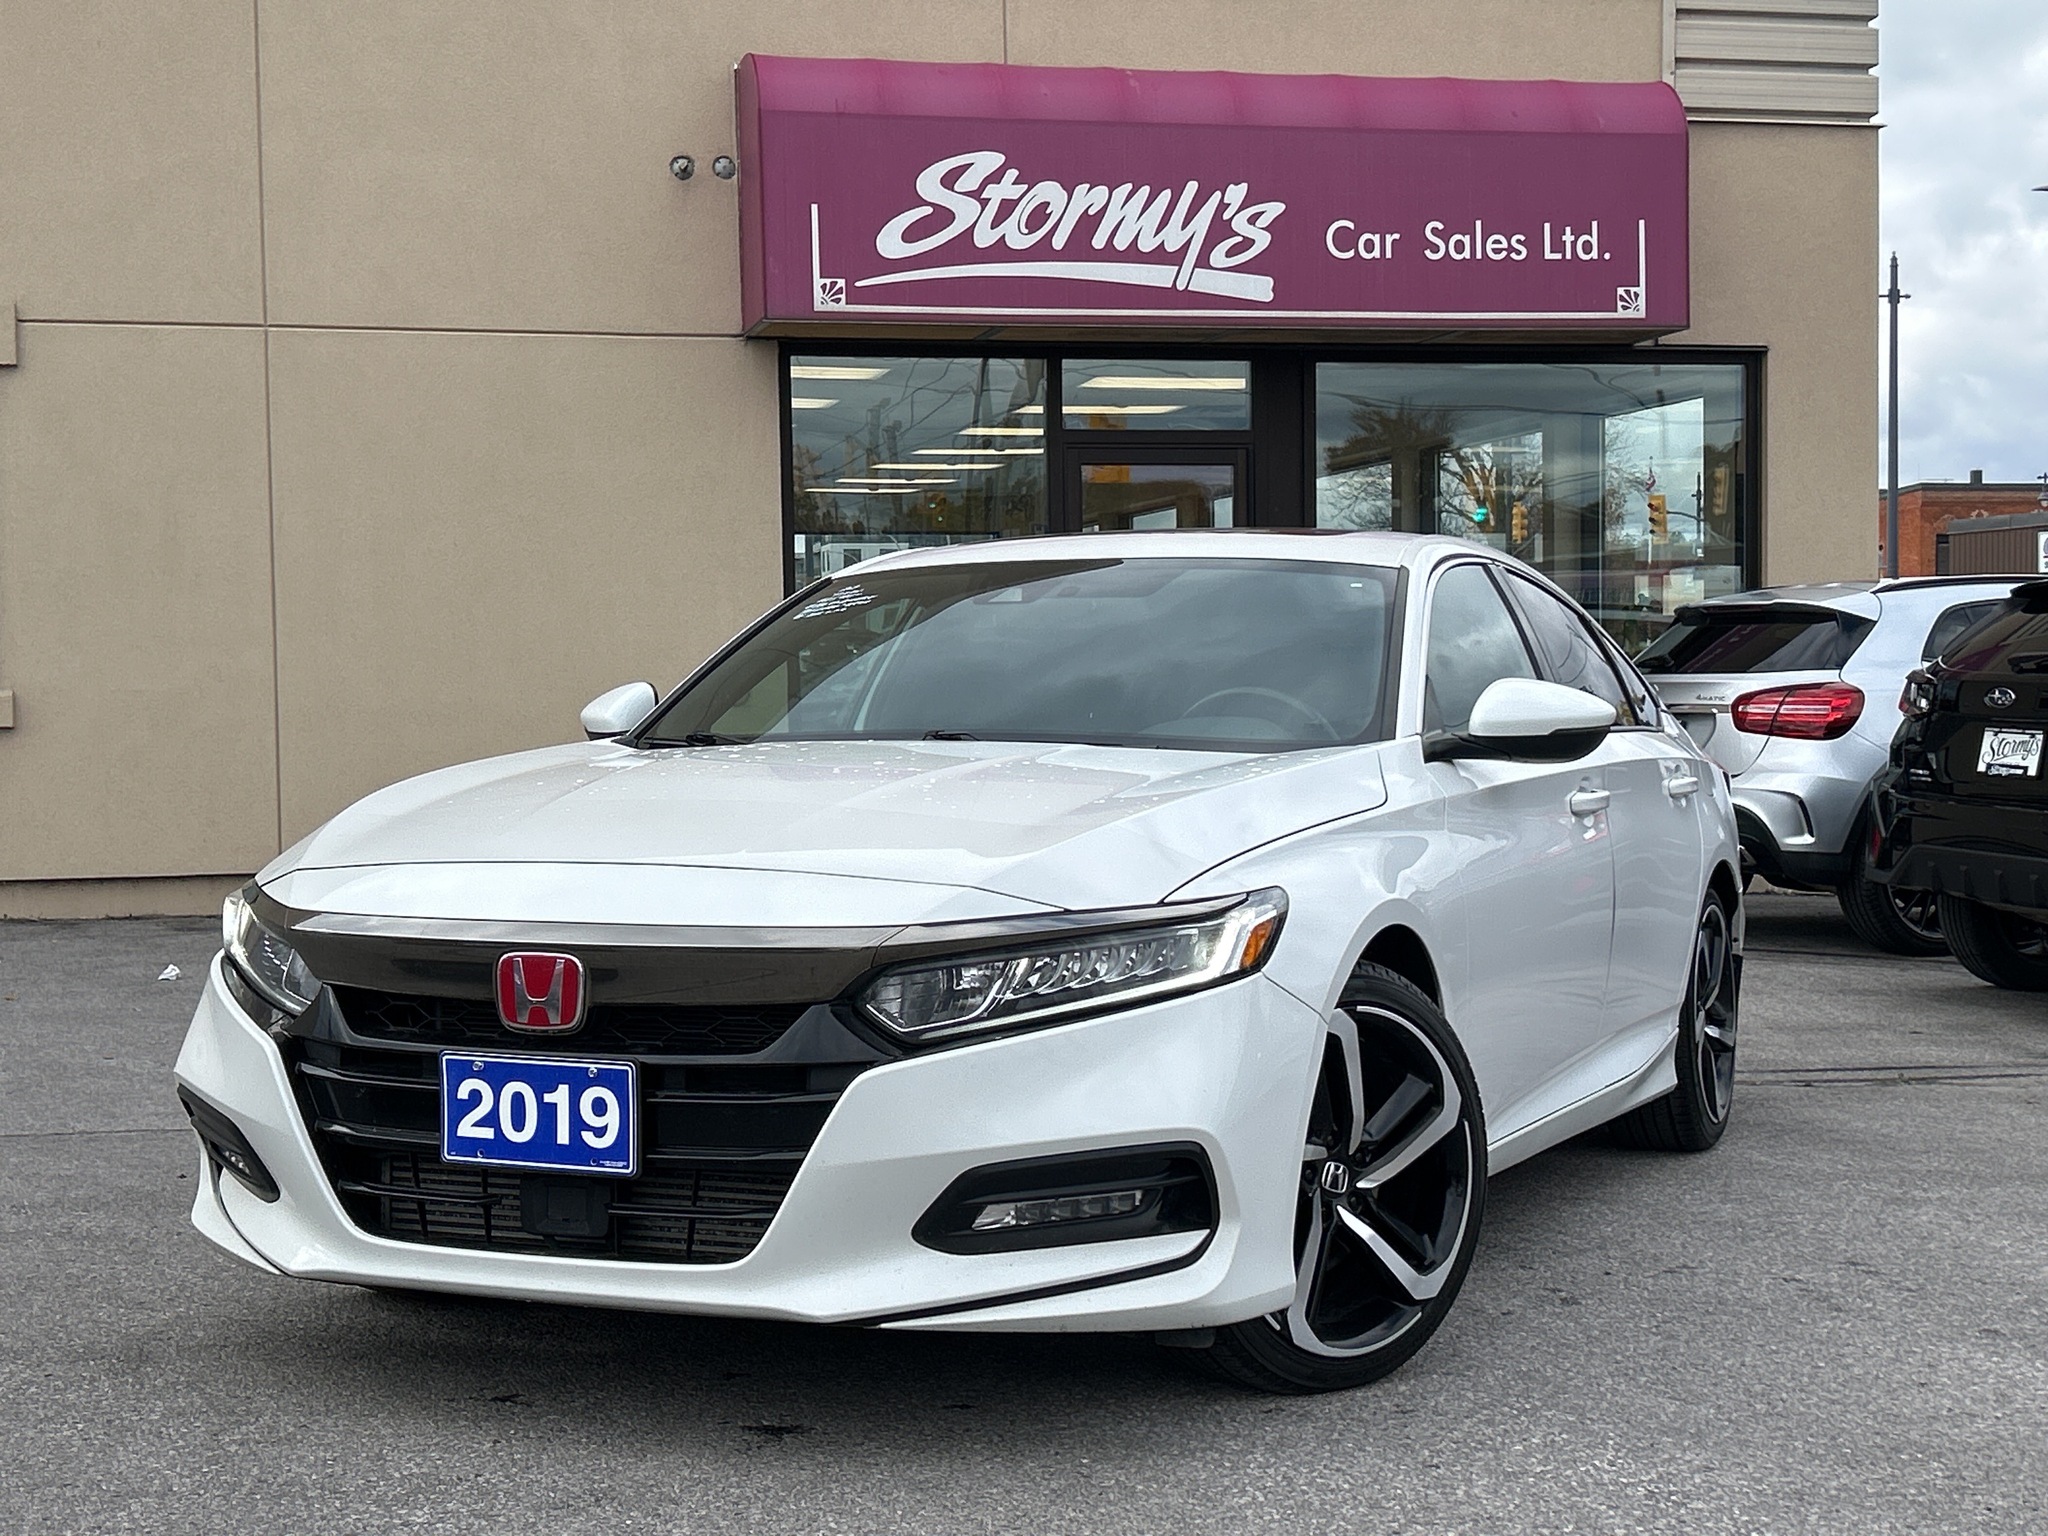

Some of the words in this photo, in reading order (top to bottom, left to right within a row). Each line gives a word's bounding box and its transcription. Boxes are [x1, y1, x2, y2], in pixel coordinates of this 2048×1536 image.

[876, 150, 1287, 291] Stormy's
[1325, 219, 1401, 260] Car
[1423, 219, 1528, 261] Sales
[1543, 219, 1611, 261] Ltd.
[456, 1078, 620, 1149] 2019
